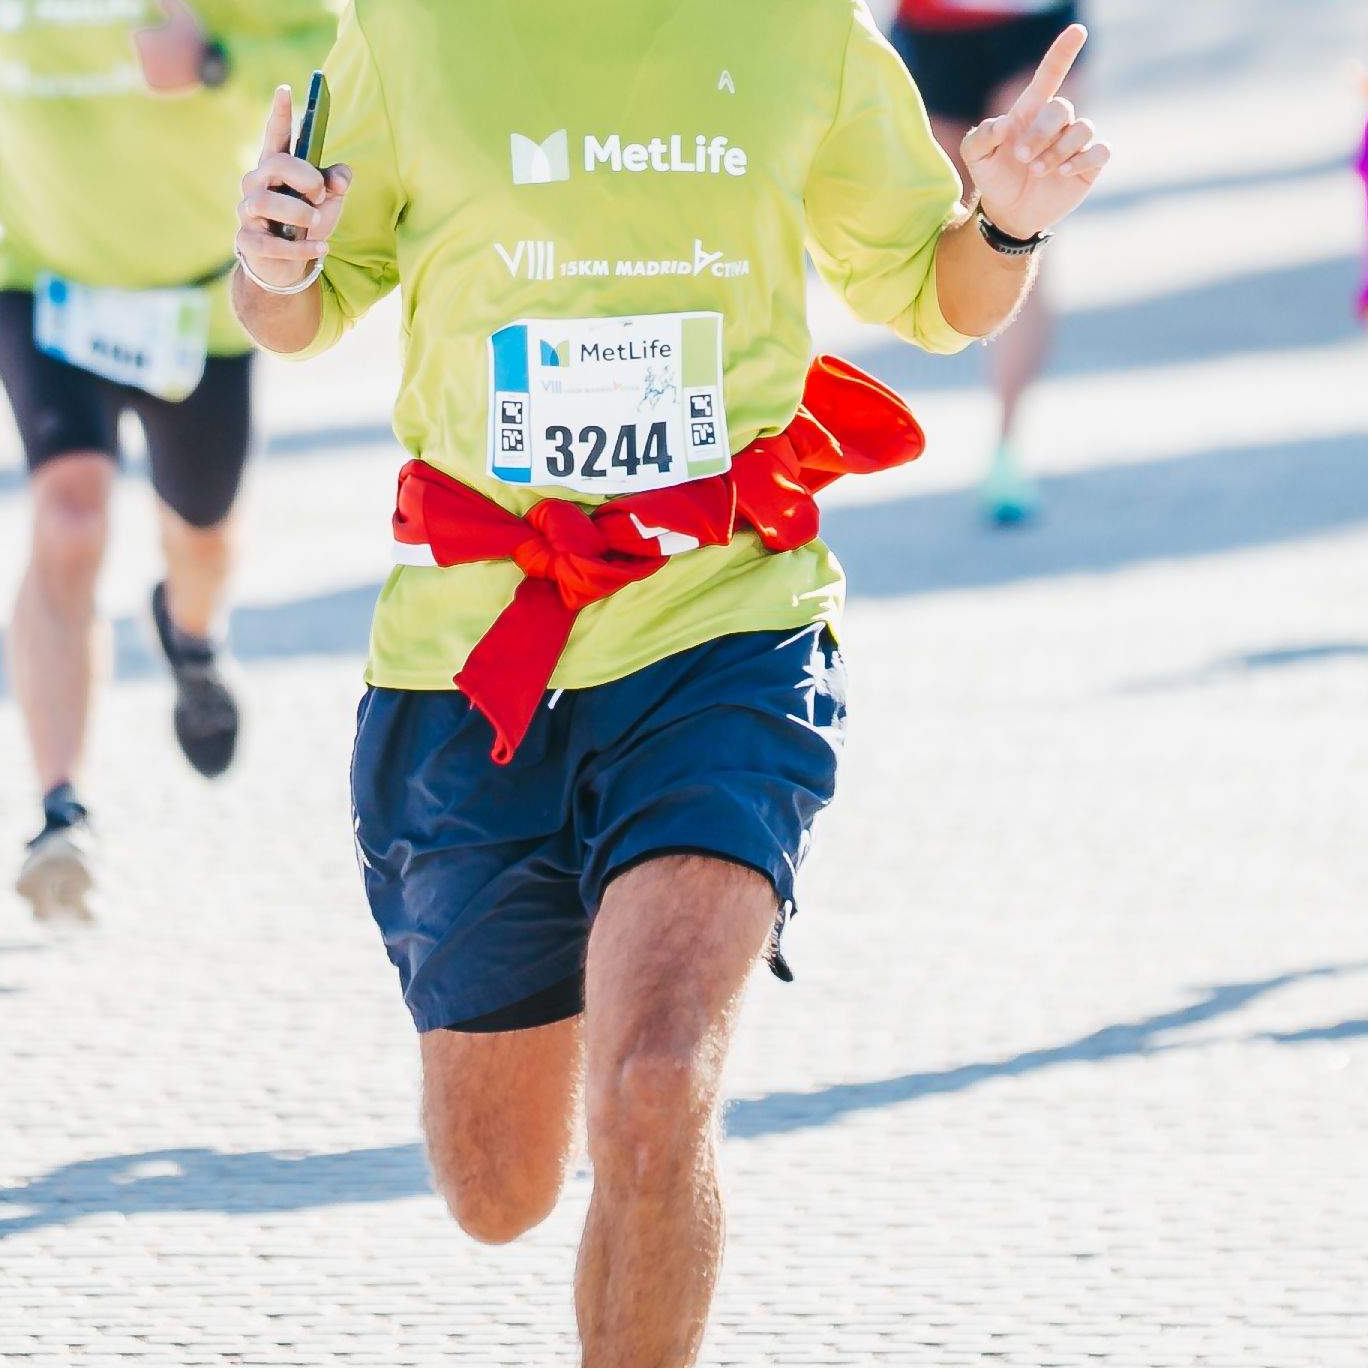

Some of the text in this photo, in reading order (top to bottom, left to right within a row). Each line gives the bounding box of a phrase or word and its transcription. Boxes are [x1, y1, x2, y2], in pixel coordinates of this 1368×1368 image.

[583, 134, 748, 176] MetLife
[494, 240, 555, 280] VIII
[560, 261, 610, 277] 15KM
[580, 338, 672, 363] MetLife
[545, 421, 673, 477] 3244
